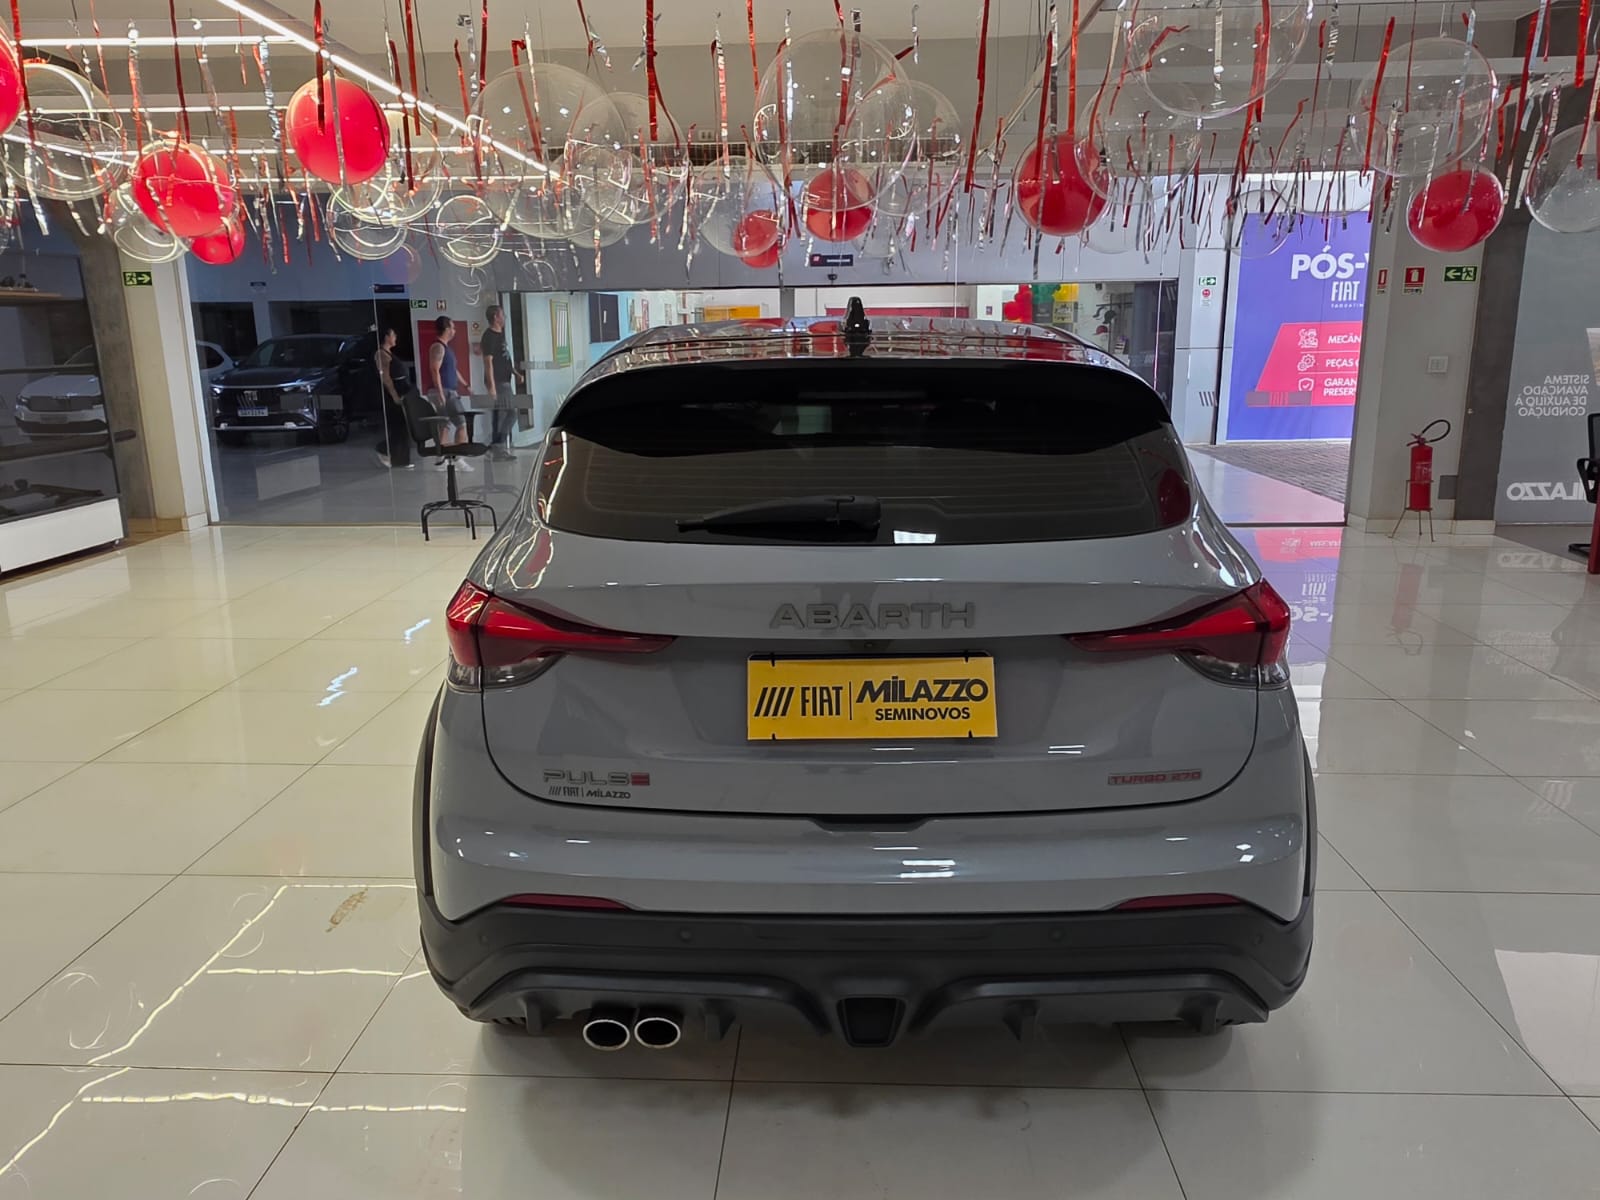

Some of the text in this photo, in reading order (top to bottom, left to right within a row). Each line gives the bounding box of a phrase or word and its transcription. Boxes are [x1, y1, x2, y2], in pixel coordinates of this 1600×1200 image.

[1331, 281, 1360, 301] FIAT
[1326, 359, 1353, 369] PEÇAS
[770, 602, 975, 630] ABARTH
[801, 686, 843, 717] FIAT
[875, 707, 970, 721] SEMINOVOS
[543, 769, 650, 786] PULSE
[563, 786, 579, 797] FIAT
